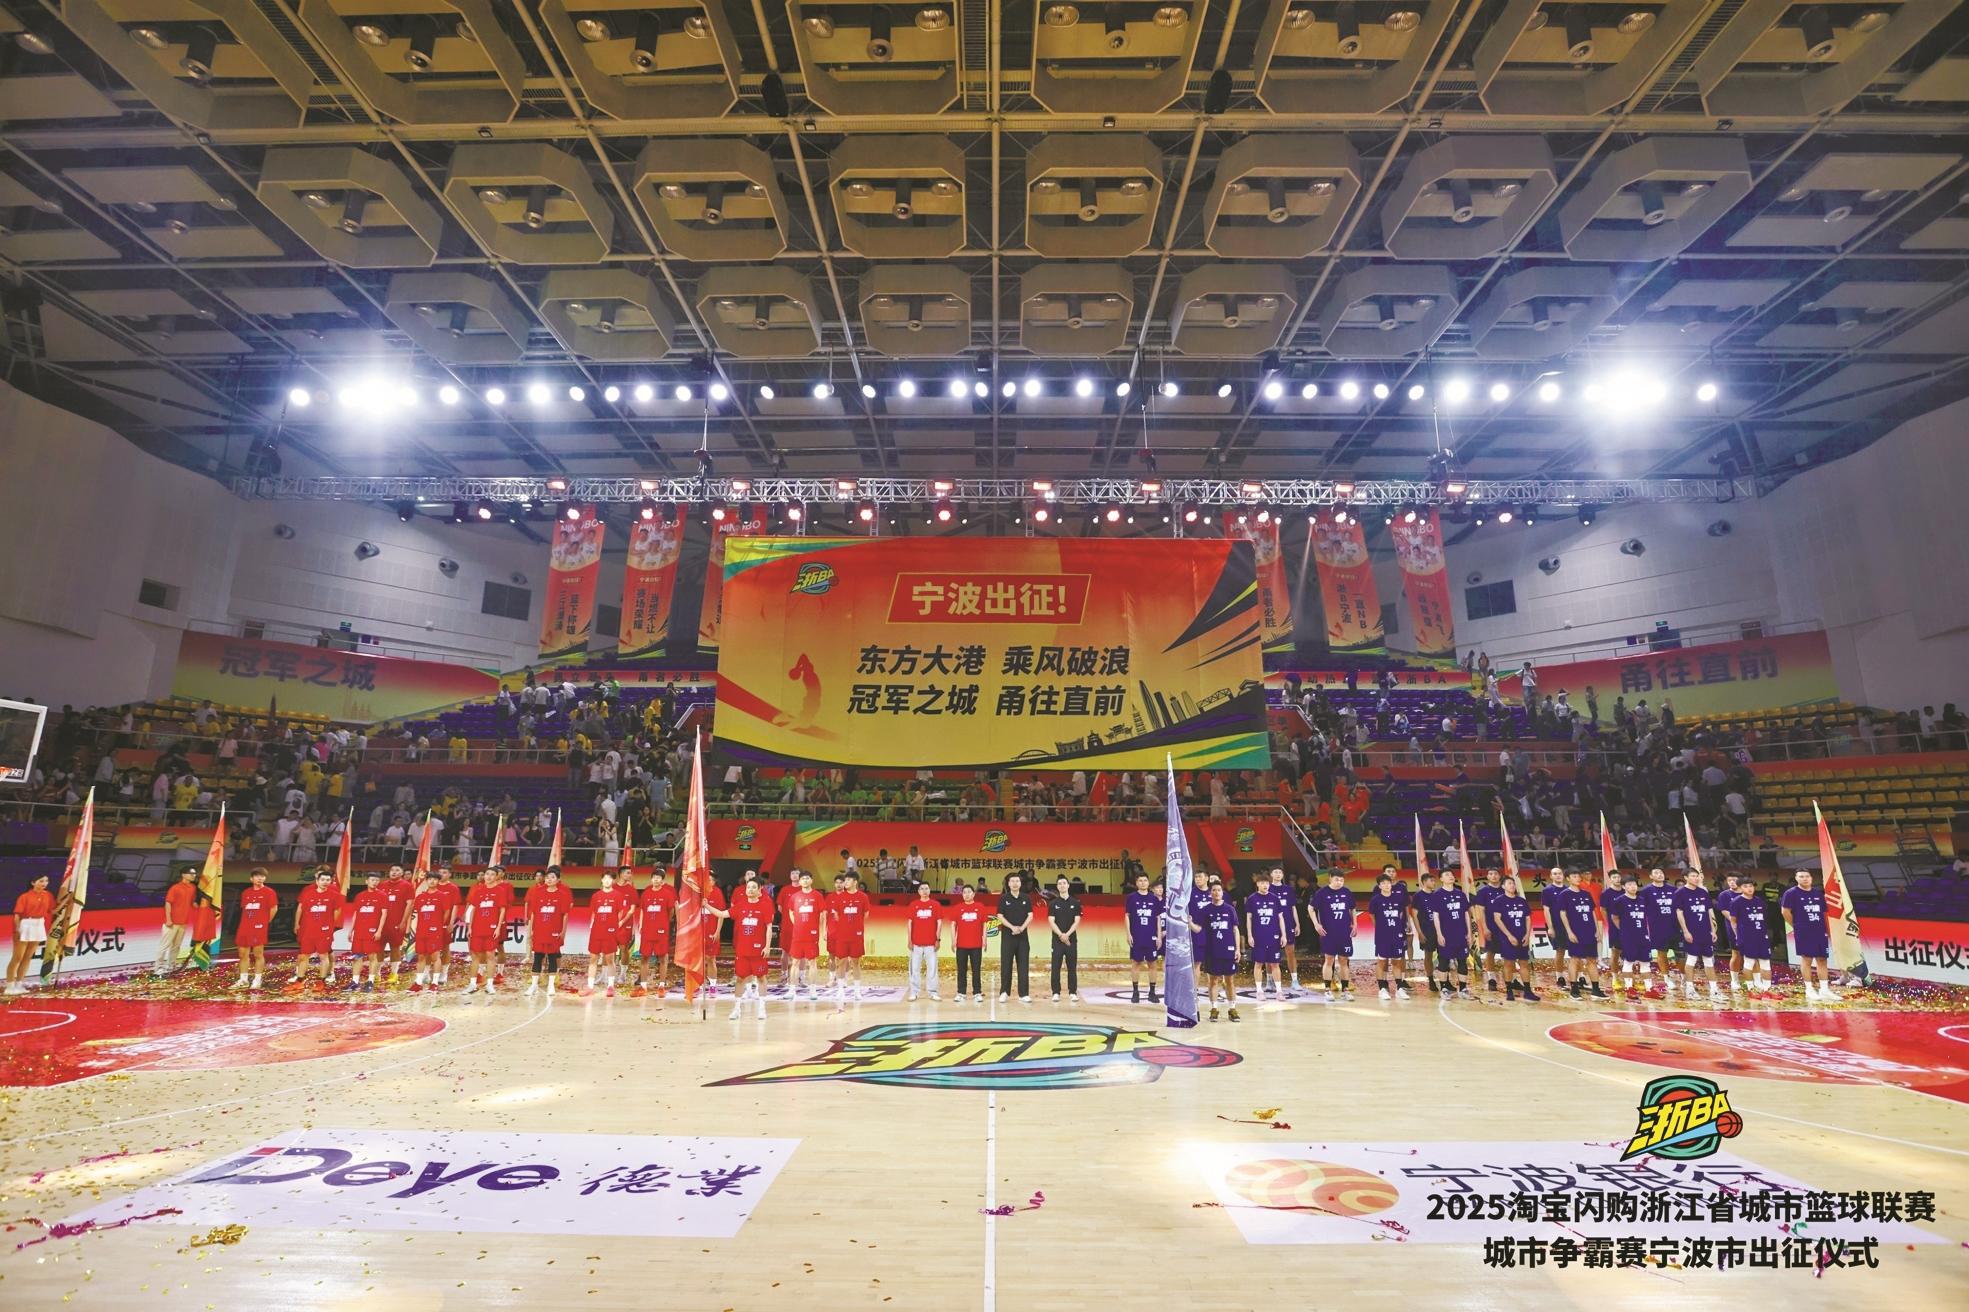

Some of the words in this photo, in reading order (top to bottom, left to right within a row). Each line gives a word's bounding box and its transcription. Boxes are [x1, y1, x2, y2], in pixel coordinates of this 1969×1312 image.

[911, 581, 1067, 616] 宁波出征!
[856, 644, 987, 676] 东方大港
[1001, 645, 1131, 677] 乘风破浪
[219, 643, 377, 692] 冠军之城
[1620, 645, 1779, 694] 甬往直前
[847, 684, 980, 716] 冠军之城
[995, 685, 1127, 717] 甬往直前
[1333, 911, 1343, 920] 77
[1697, 913, 1703, 922] 7
[1808, 913, 1820, 921] 34
[1260, 917, 1271, 925] 27
[1387, 919, 1396, 927] 14
[1515, 919, 1521, 927] 6
[1635, 920, 1642, 928] 3
[1754, 921, 1762, 930] 2
[1216, 930, 1223, 940] 4
[1884, 936, 1969, 970] 出征仪
